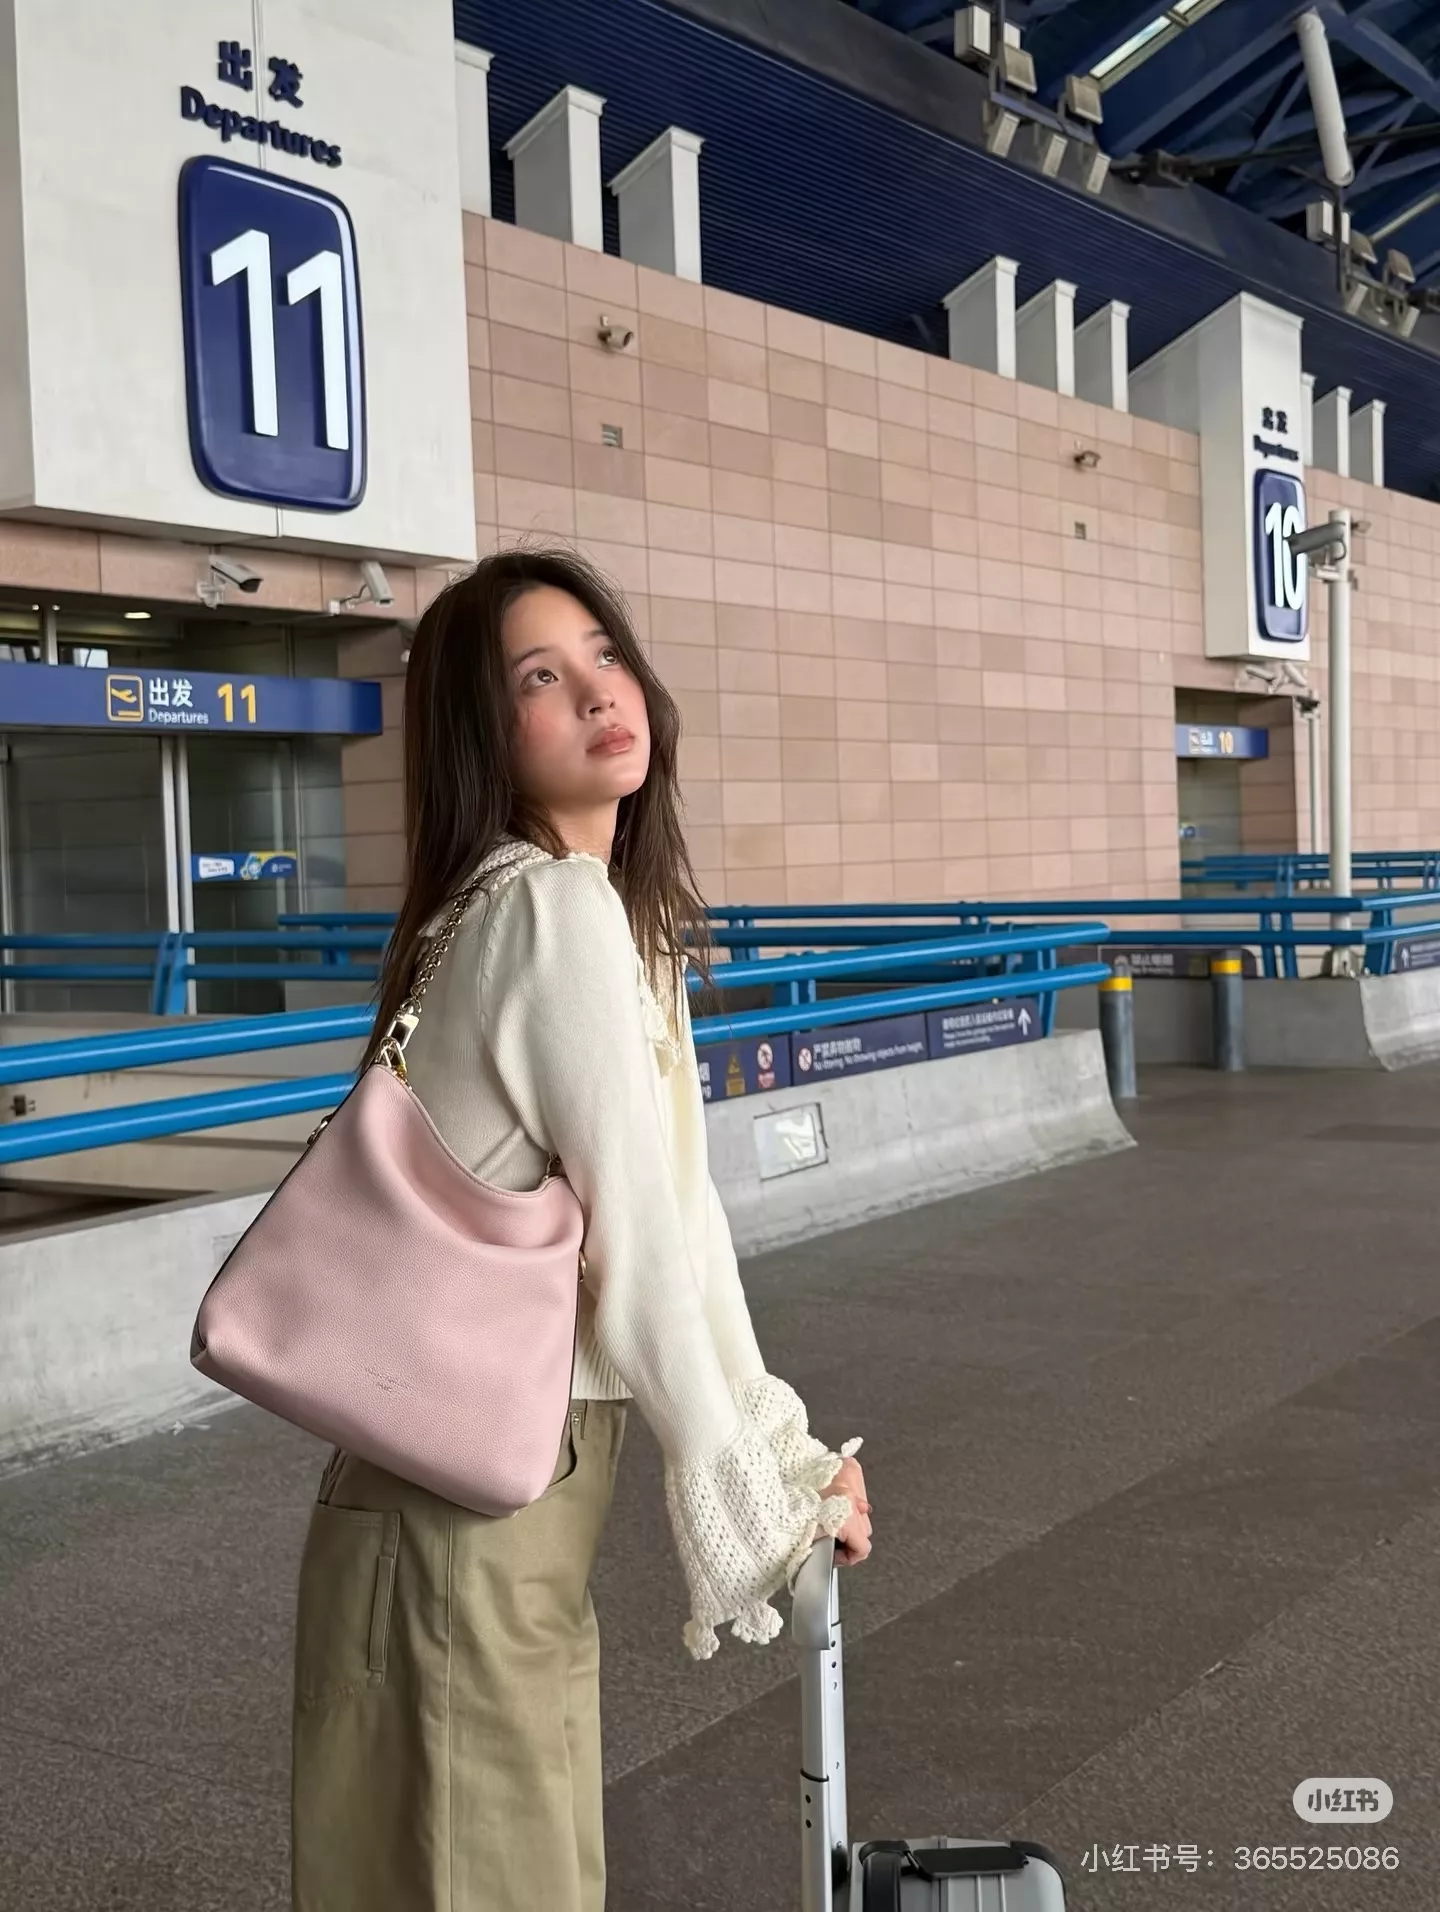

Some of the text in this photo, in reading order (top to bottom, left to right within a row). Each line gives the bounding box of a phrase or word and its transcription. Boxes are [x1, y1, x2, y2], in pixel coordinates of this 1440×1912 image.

[217, 40, 304, 108] 出发
[180, 85, 343, 168] Departures
[210, 228, 349, 451] 11
[1265, 502, 1308, 610] 10
[148, 707, 209, 725] Departures
[149, 677, 194, 708] 出发
[217, 682, 257, 724] 11
